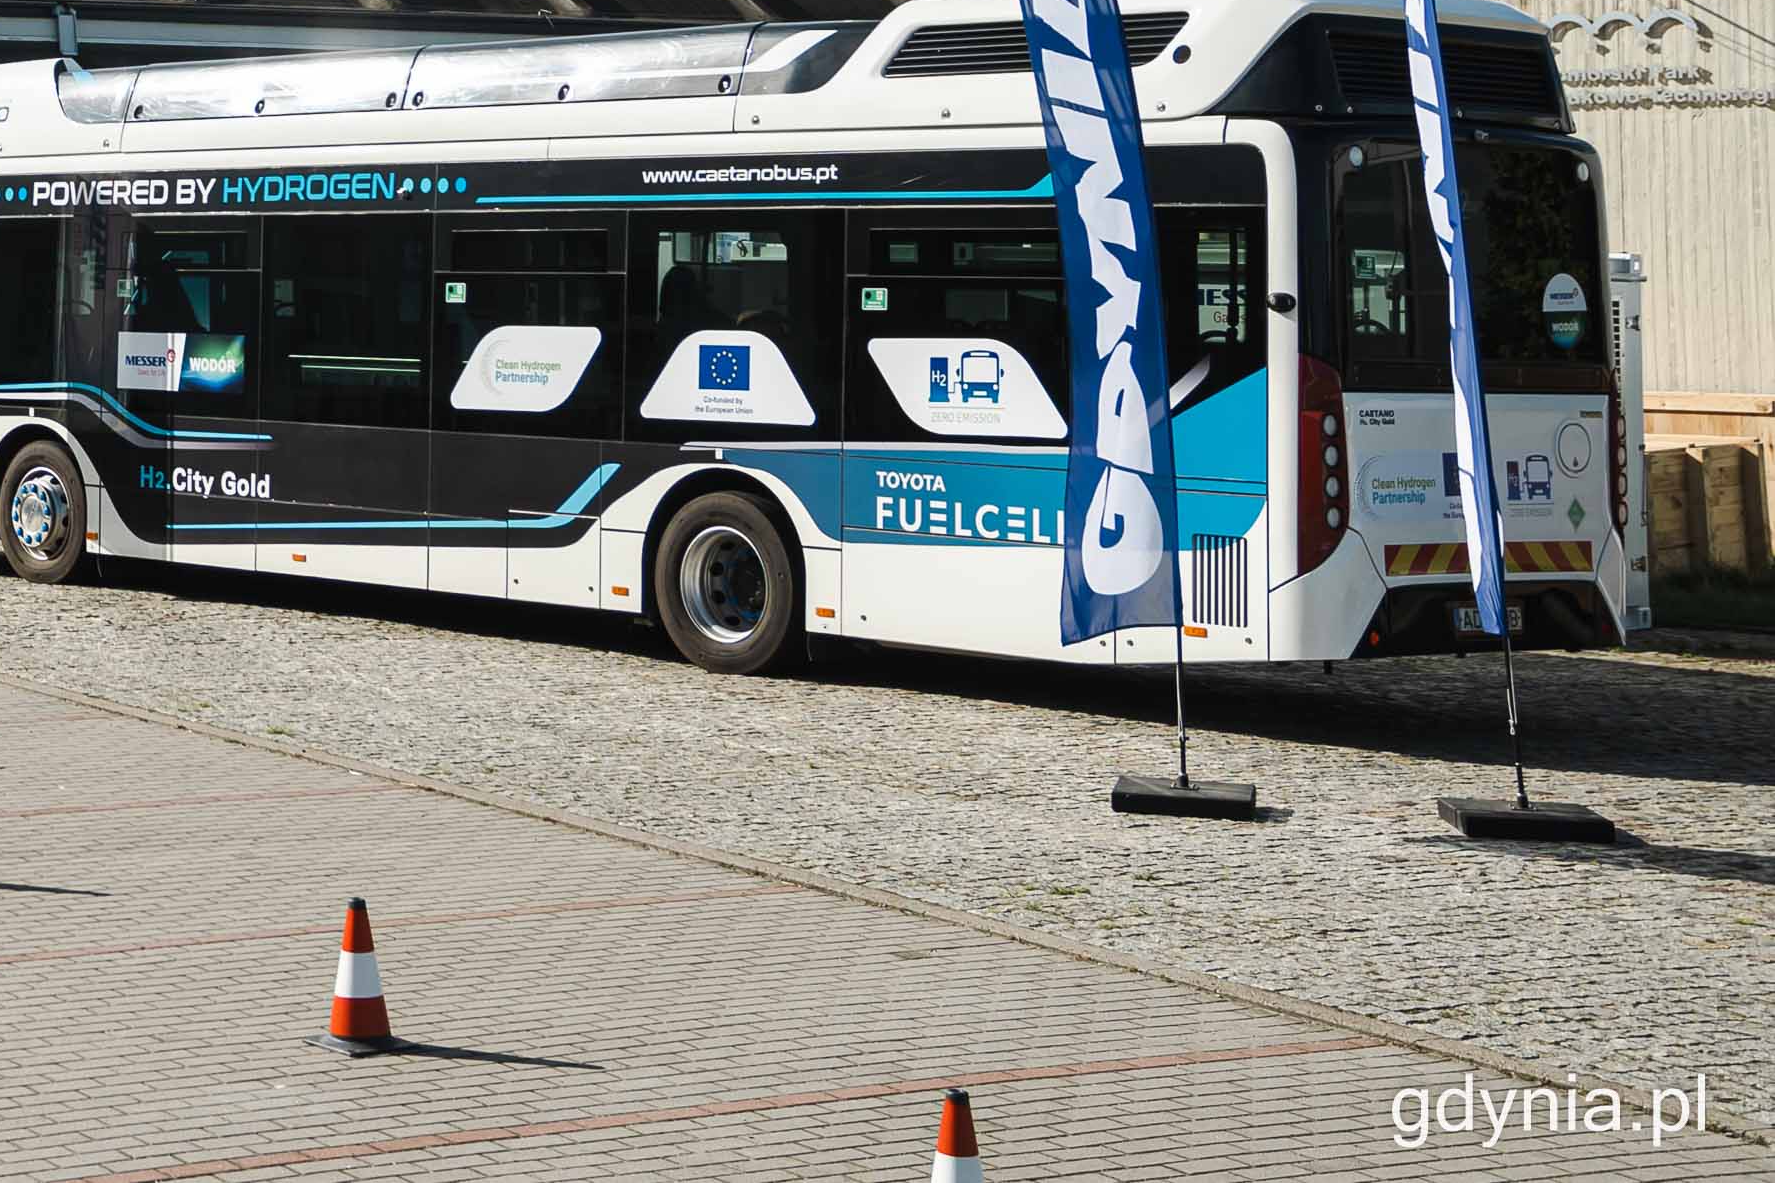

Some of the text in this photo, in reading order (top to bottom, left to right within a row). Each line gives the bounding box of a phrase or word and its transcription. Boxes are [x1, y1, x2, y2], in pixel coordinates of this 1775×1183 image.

[1562, 67, 1649, 82] morski
[642, 164, 838, 184] www.caetanobus.pt
[32, 172, 395, 207] POWERED BY HYDROGEN
[126, 355, 166, 367] MESSER
[496, 359, 561, 374] Clean Hydrogen
[495, 371, 548, 385] Partnership
[931, 370, 946, 386] H2
[931, 412, 1001, 424] ZERO EMISSION
[1359, 410, 1395, 418] CAETANO
[221, 471, 270, 498] Gold
[876, 471, 946, 492] TOYOTA
[1372, 476, 1436, 492] Clean Hydrogen
[1372, 492, 1426, 506] Partnership
